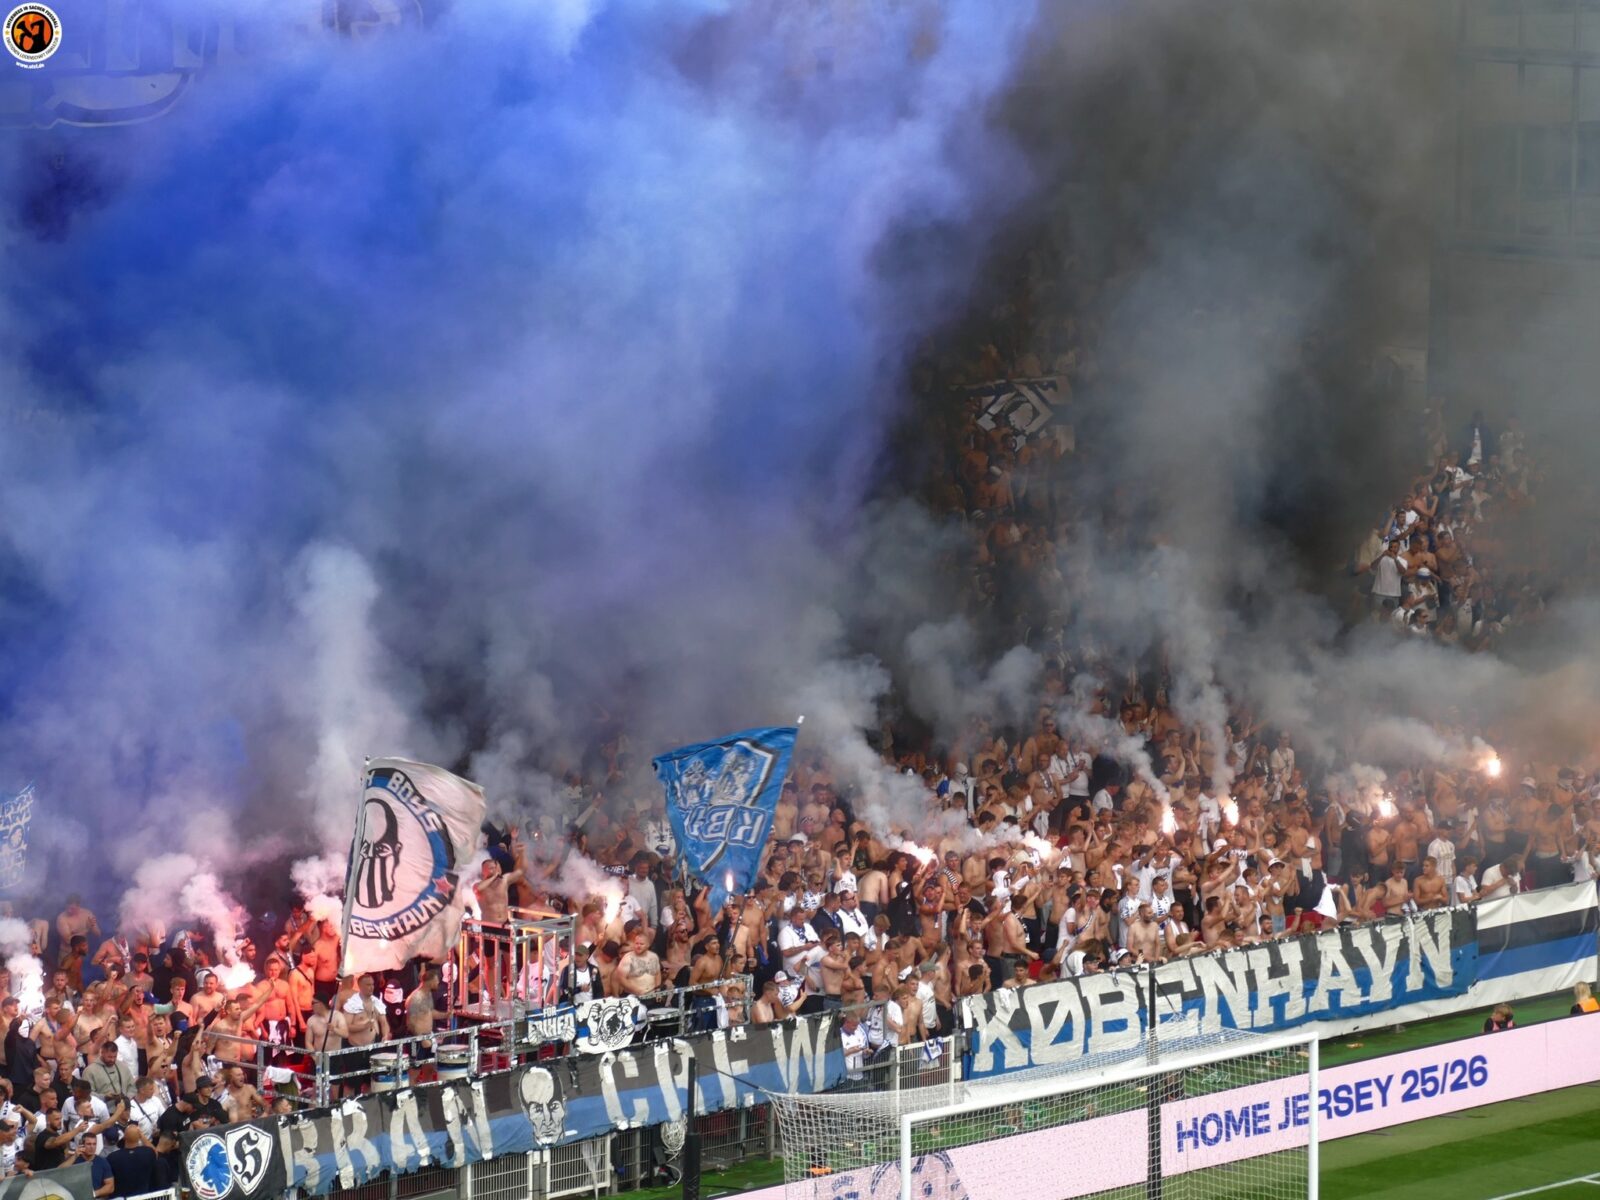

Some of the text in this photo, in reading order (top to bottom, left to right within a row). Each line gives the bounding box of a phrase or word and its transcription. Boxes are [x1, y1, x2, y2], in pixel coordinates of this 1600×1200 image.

[386, 770, 443, 833] BOYS
[543, 1006, 557, 1018] FOR
[970, 911, 1454, 1072] KØBENHAVN
[599, 1014, 834, 1130] CREW
[1176, 1055, 1488, 1153] HOME JERSEY 25/26
